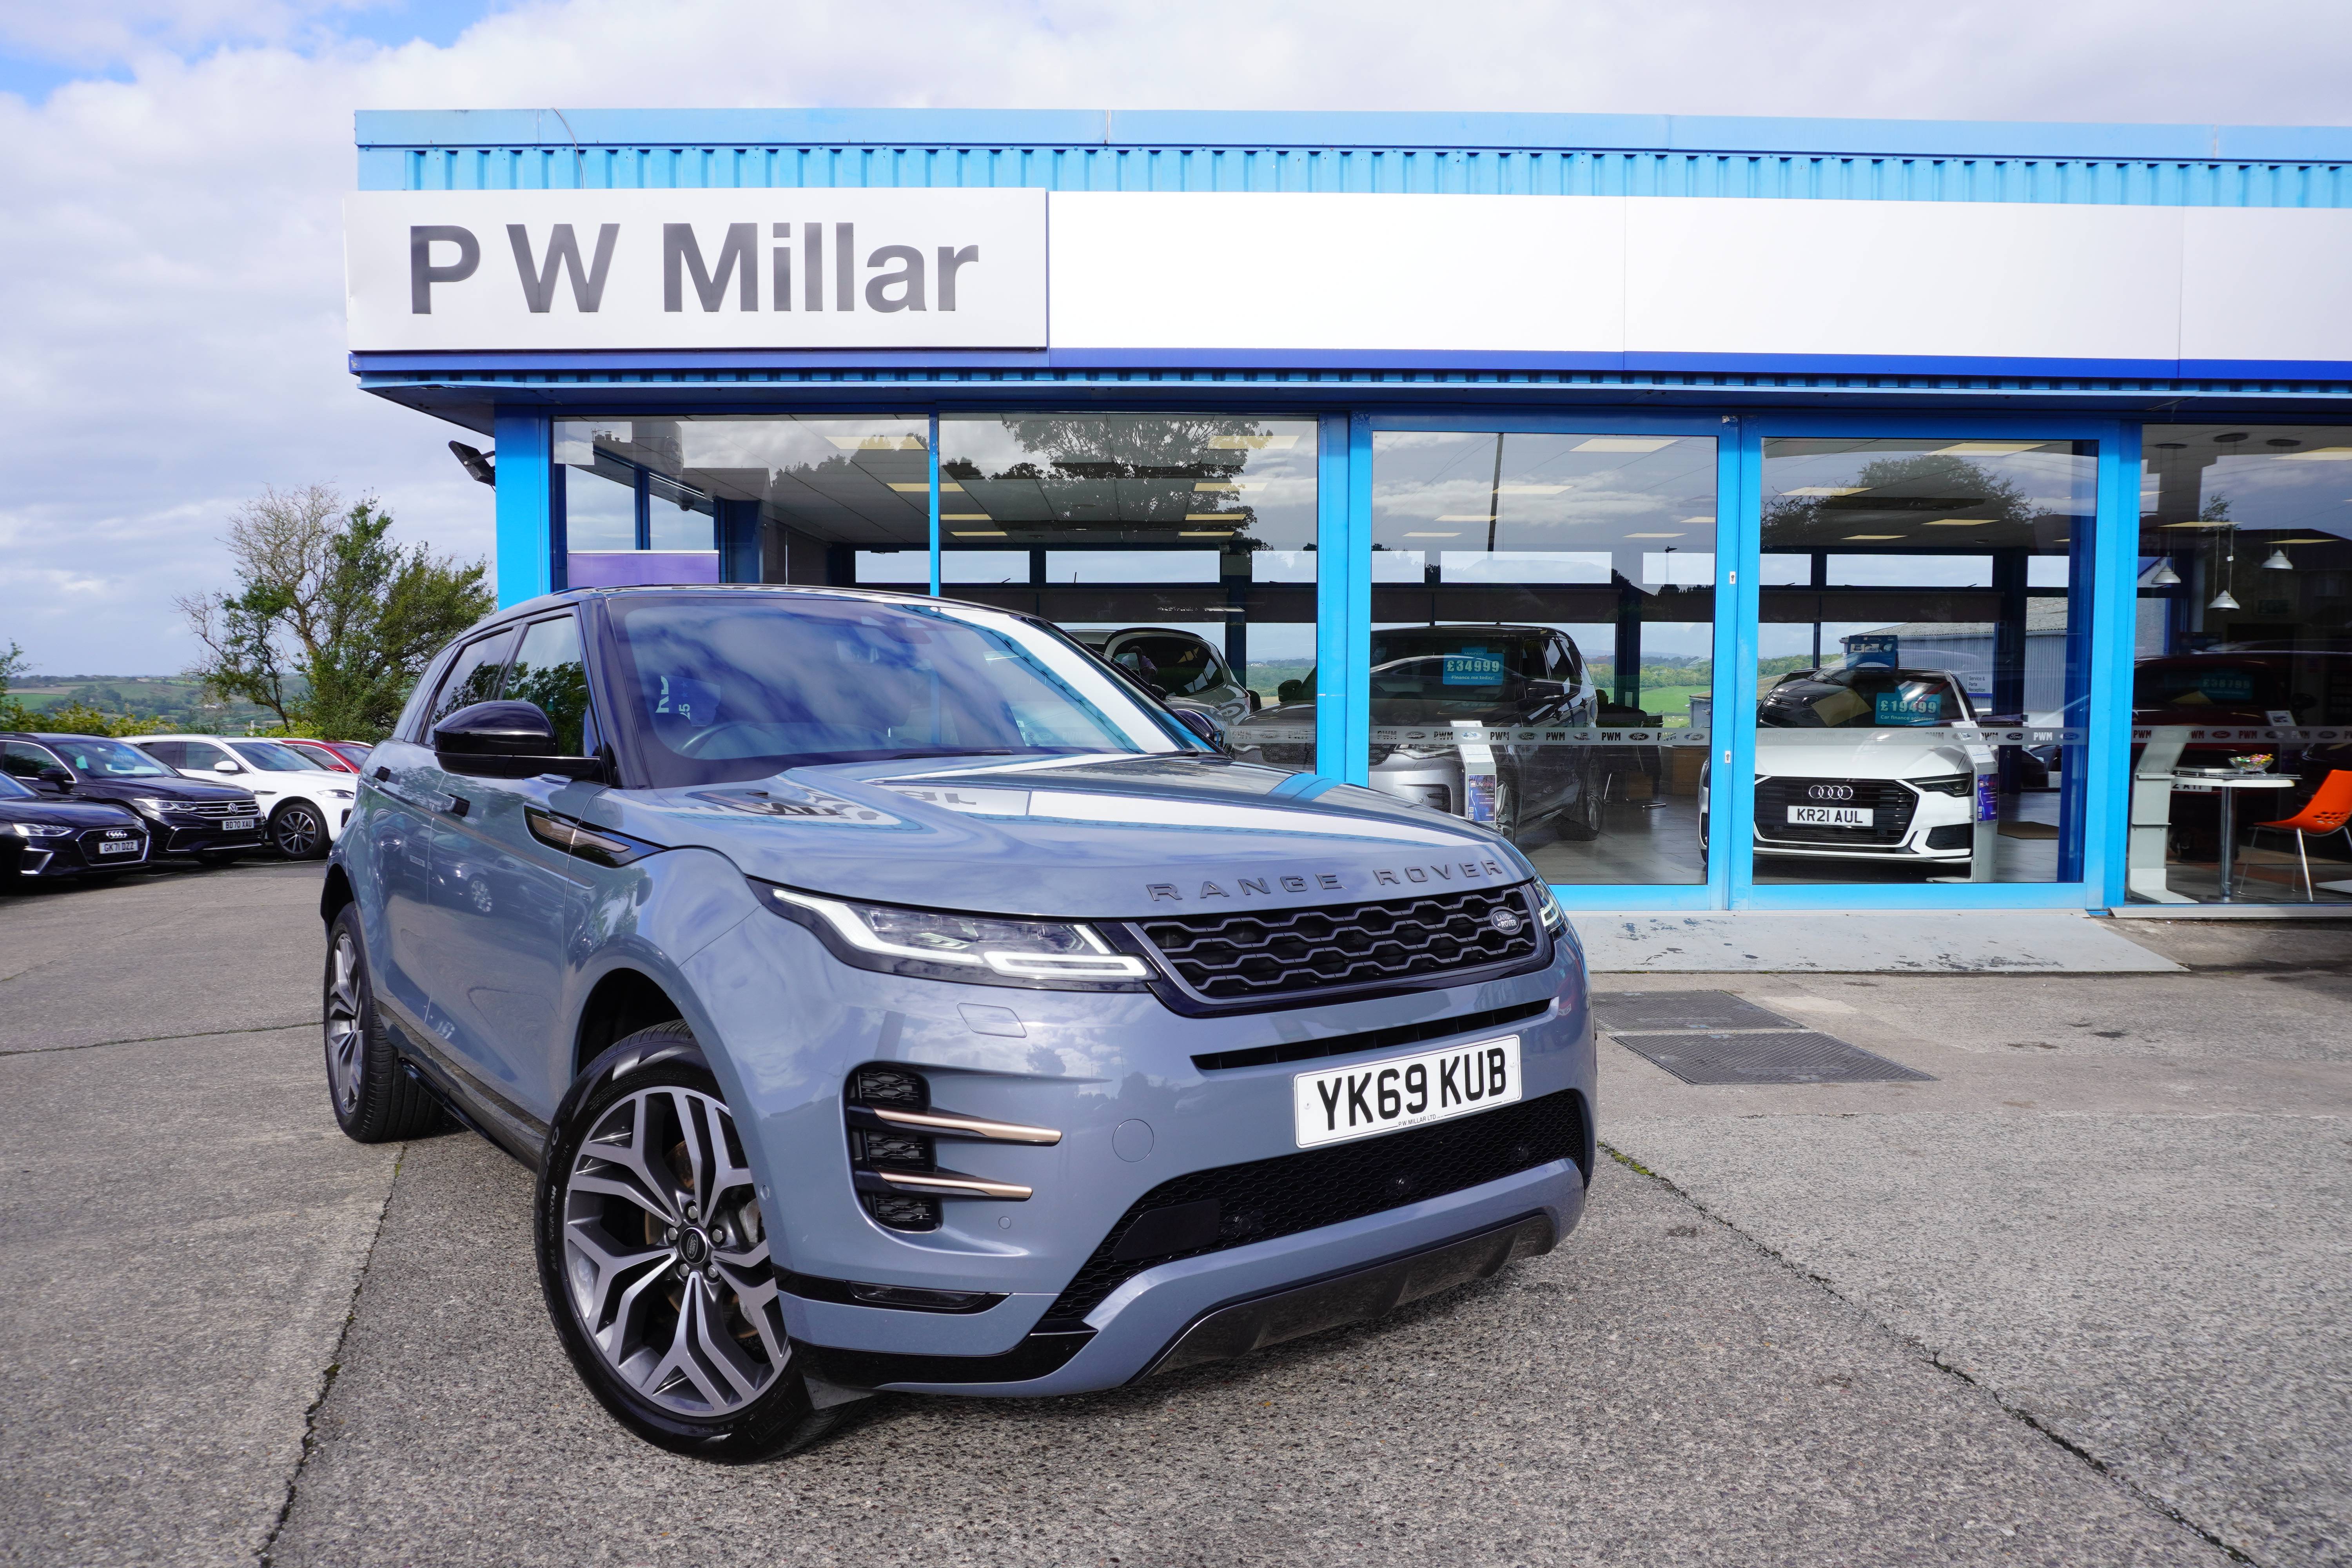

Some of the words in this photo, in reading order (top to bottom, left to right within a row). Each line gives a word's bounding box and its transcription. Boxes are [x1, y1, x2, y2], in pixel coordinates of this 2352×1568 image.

[410, 225, 480, 314] P
[506, 224, 620, 313] W
[662, 222, 979, 312] Millar
[1447, 660, 1499, 672] £34999
[1880, 700, 1936, 713] £19499
[1434, 731, 1453, 740] PWM
[1490, 732, 1509, 740] PWM
[1546, 732, 1565, 740] PWM
[1602, 732, 1621, 741] PWM
[1980, 732, 1998, 741] PWM
[2034, 732, 2053, 741] PWM
[2133, 730, 2152, 739] PWM
[2239, 730, 2257, 739] PWM
[1797, 808, 1829, 822] KR21
[1835, 810, 1863, 823] AUL
[104, 843, 120, 851] GK71
[122, 842, 134, 850] DZZ
[1146, 872, 1342, 901] RANGE
[1372, 860, 1503, 885] ROVER
[1500, 919, 1517, 928] ROVER
[1317, 1063, 1427, 1131] YK69
[1440, 1047, 1506, 1108] KUB
